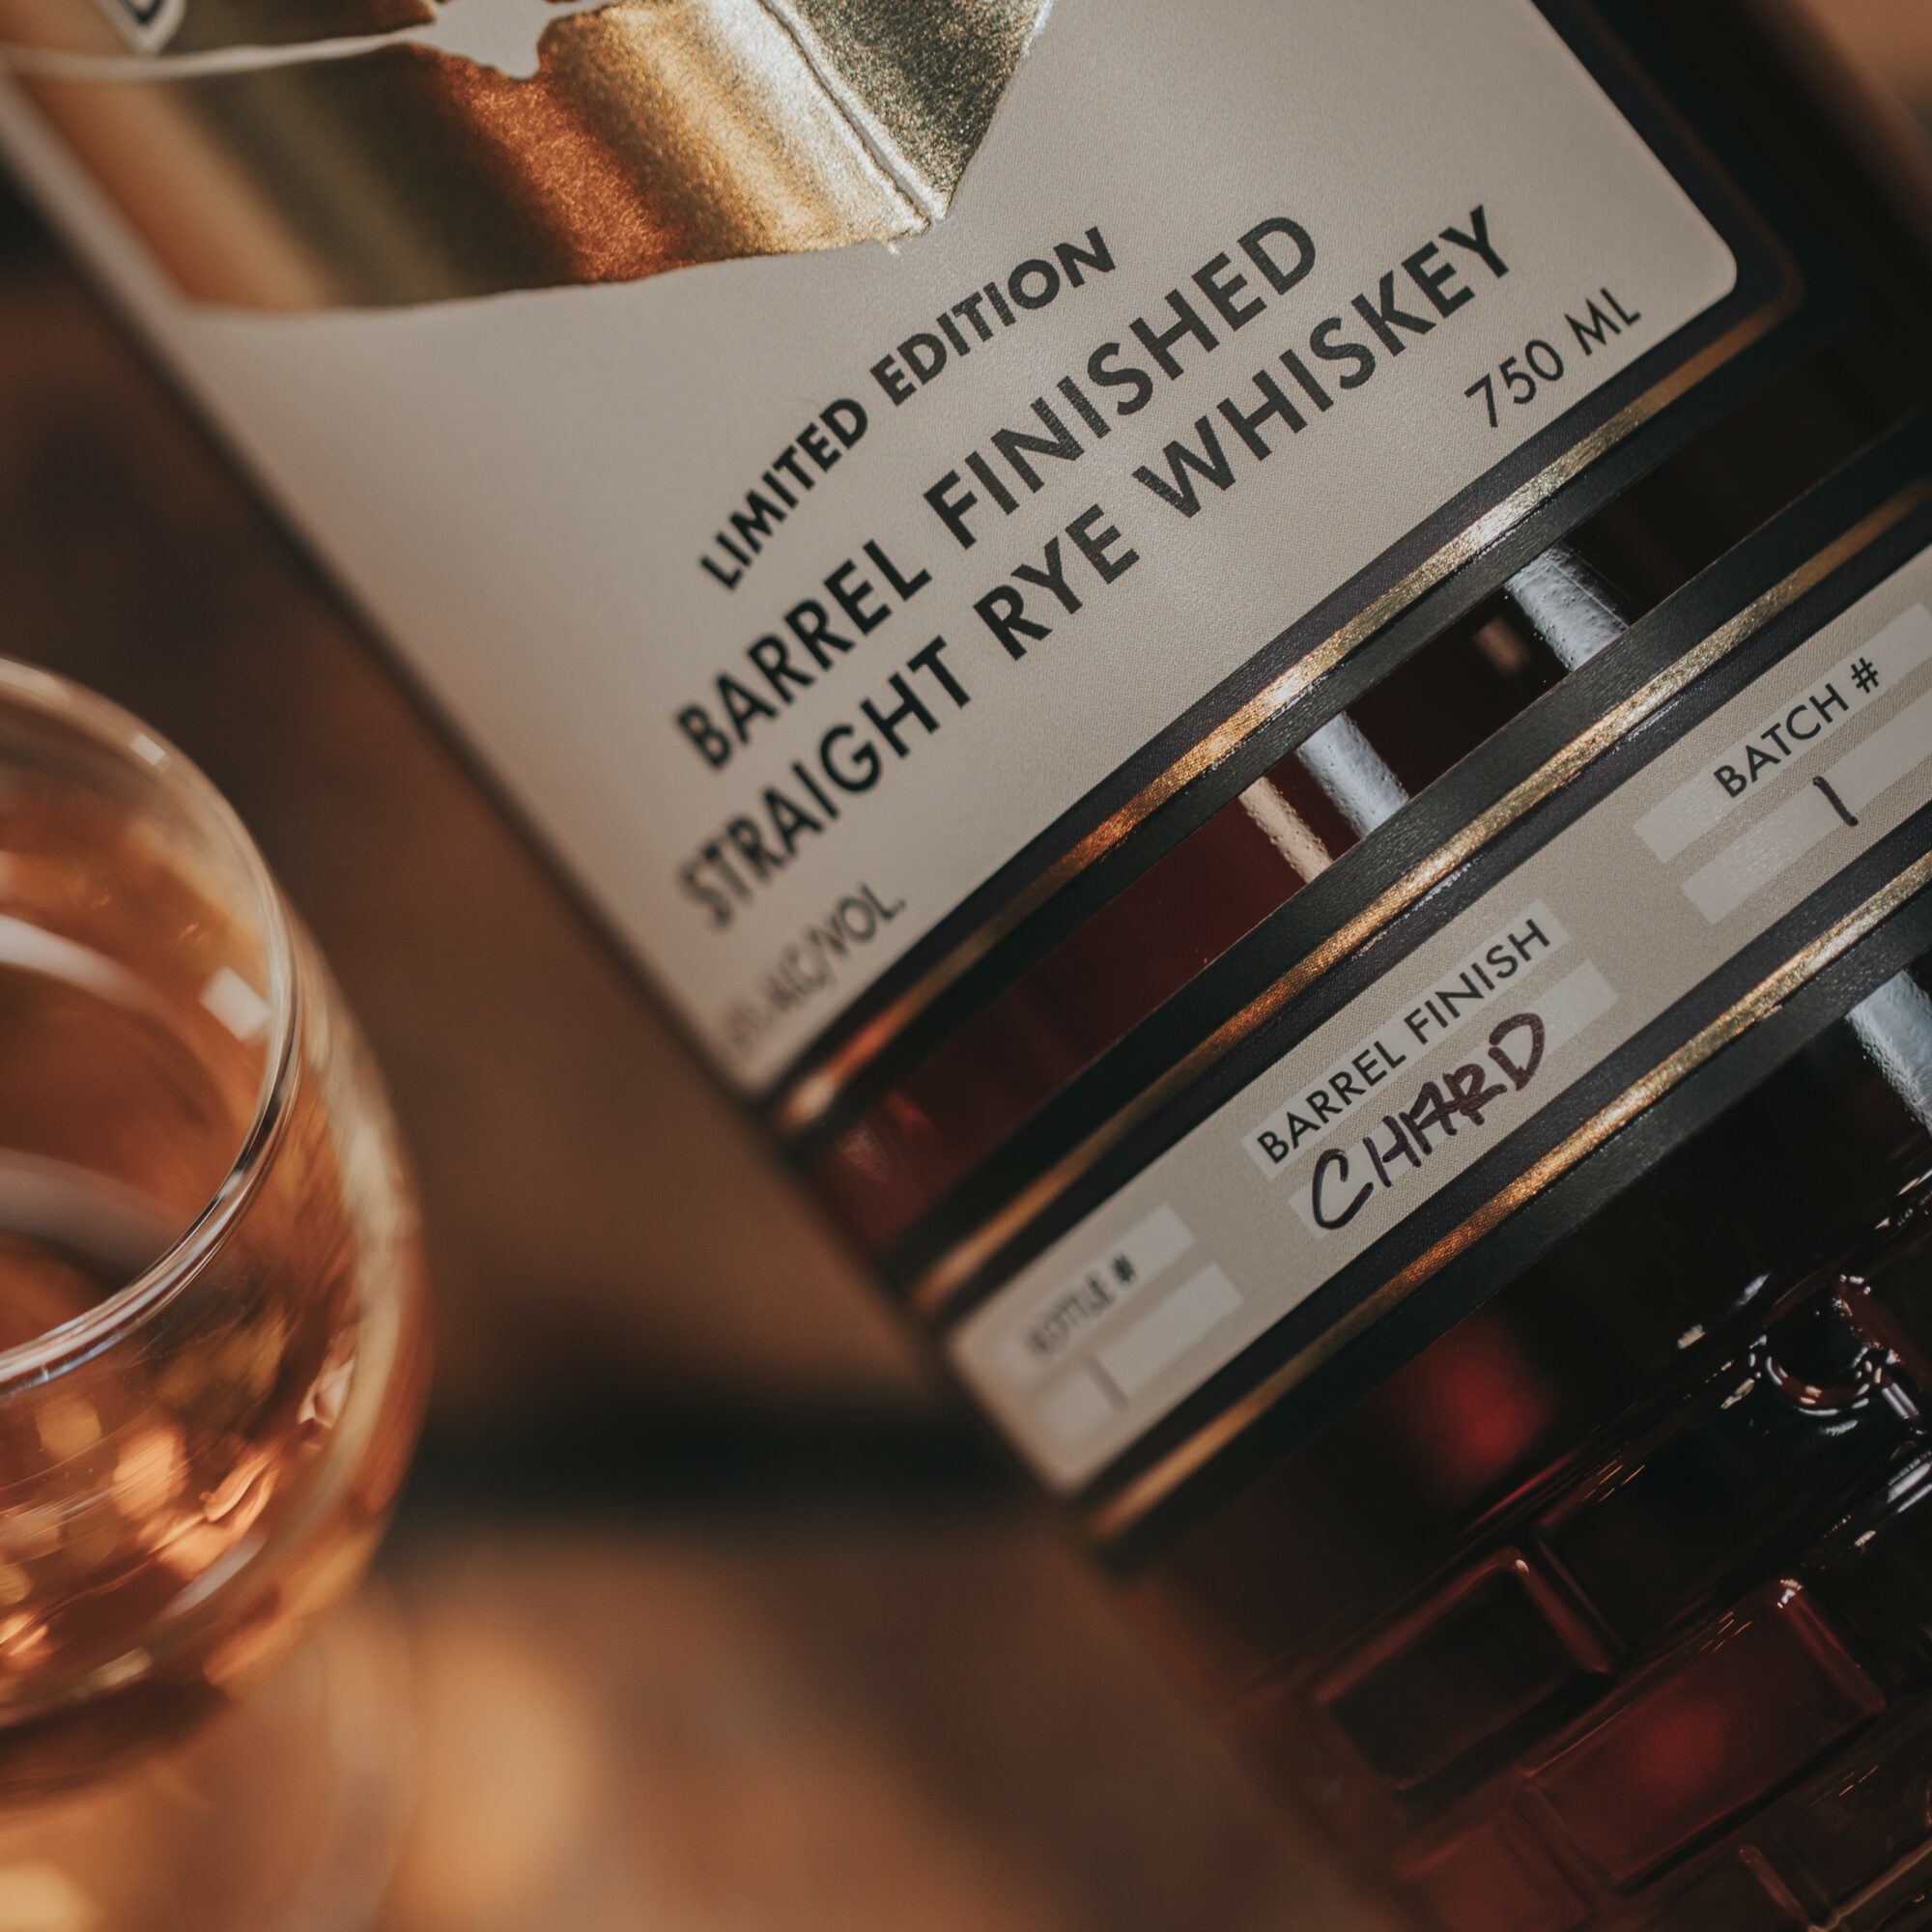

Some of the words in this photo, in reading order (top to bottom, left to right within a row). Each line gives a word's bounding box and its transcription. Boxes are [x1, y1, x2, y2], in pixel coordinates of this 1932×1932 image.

[699, 397, 868, 592] LIMITED
[869, 226, 1116, 407] EDITION
[1463, 339, 1565, 428] 750
[1564, 288, 1641, 355] ML
[675, 539, 932, 771] BARREL
[923, 216, 1316, 550] FINISHED
[680, 635, 971, 930] STRAIGHT
[973, 503, 1140, 661] RYE
[1131, 204, 1509, 519] WHISKEY
[1714, 683, 1849, 798] BATCH
[1851, 657, 1879, 694] #
[1258, 1041, 1406, 1164] BARREL
[1404, 919, 1550, 1044] FINISH
[1312, 1012, 1545, 1229] CHARD
